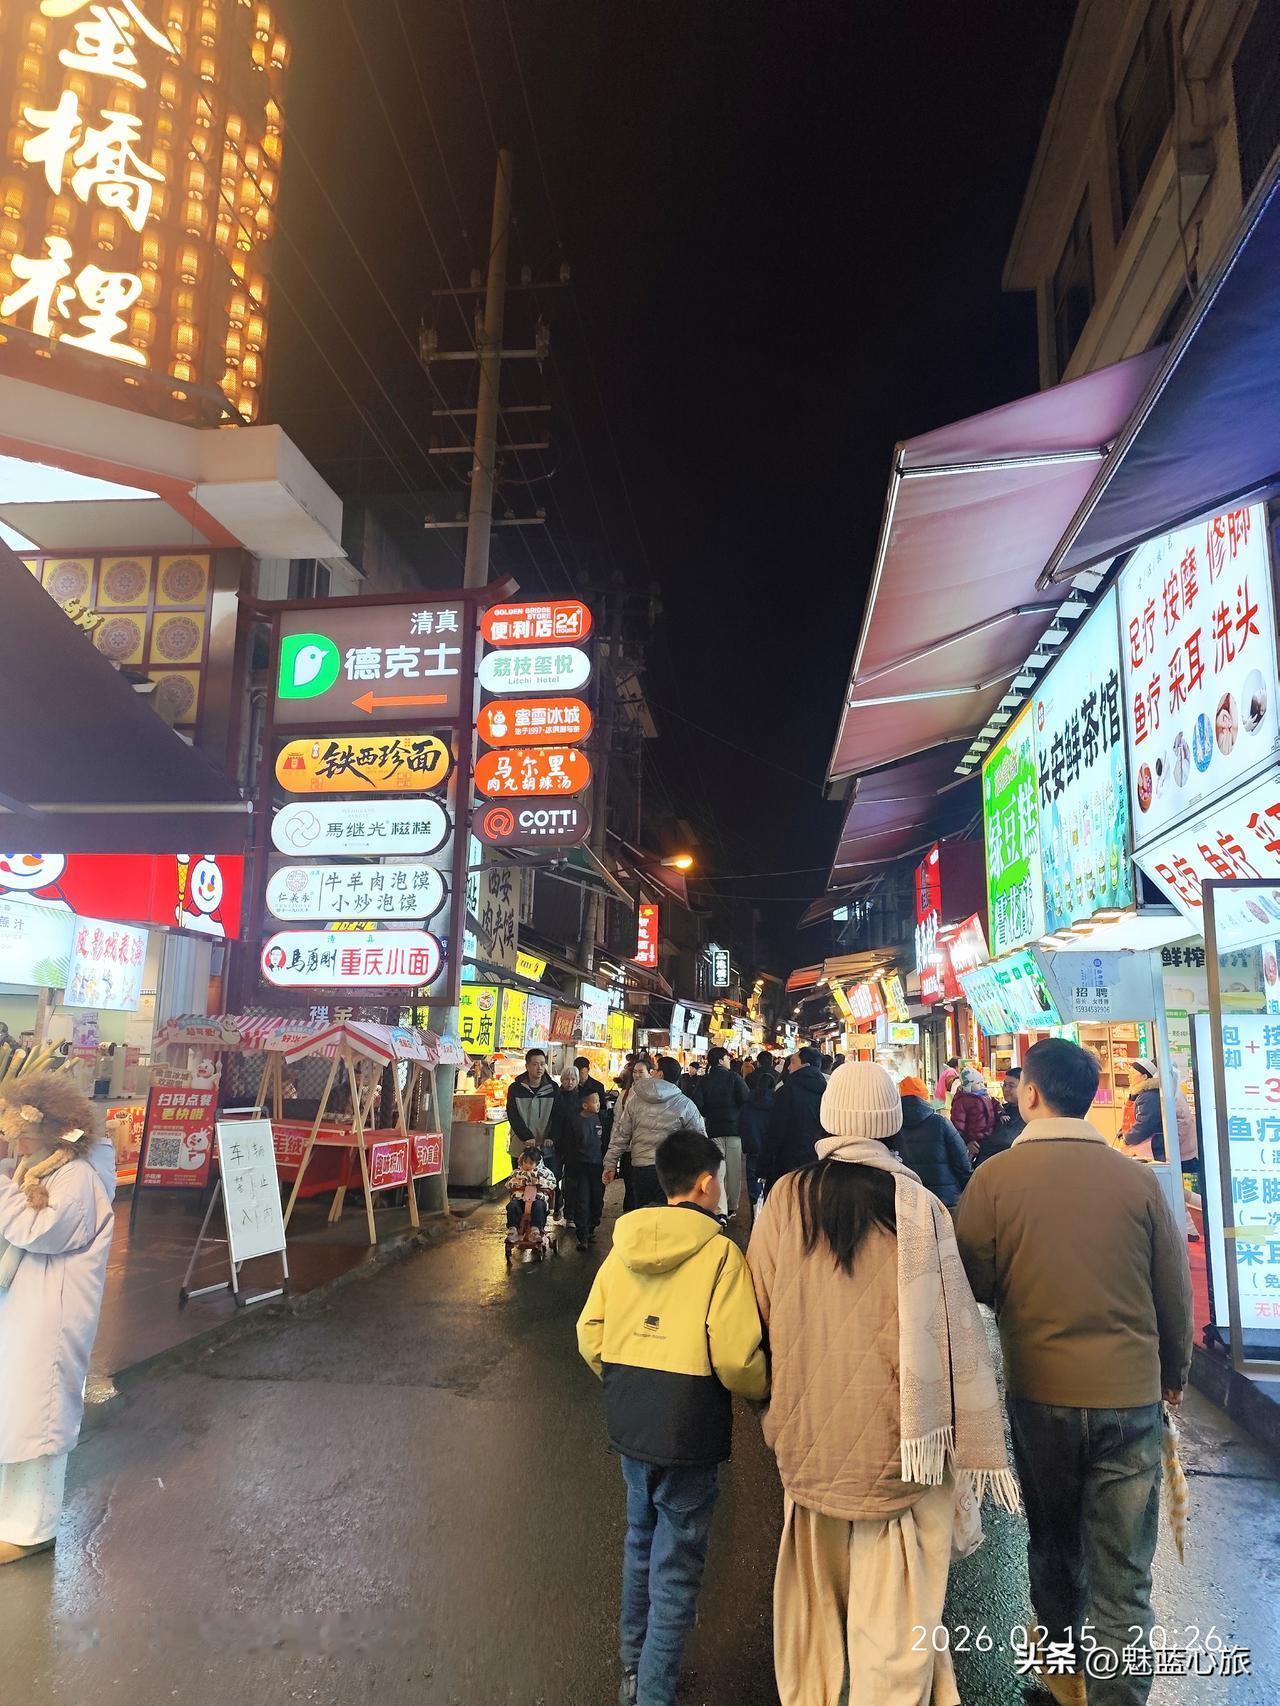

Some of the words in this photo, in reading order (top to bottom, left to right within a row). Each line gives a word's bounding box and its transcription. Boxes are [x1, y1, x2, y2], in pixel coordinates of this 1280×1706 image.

[1206, 508, 1251, 584] 修脚
[409, 609, 459, 635] 清真
[494, 608, 523, 616] GOLDEN
[525, 606, 551, 614] BRIDGE
[1129, 597, 1155, 675] 足疗
[1162, 546, 1198, 636] 按摩
[491, 619, 553, 640] 便利店
[344, 643, 461, 681] 德克士
[493, 654, 574, 677] 荔枝玺悦
[1134, 672, 1161, 746] 鱼疗
[1168, 627, 1205, 714] 采耳
[1212, 574, 1260, 674] 洗头
[508, 677, 532, 685] Litchi
[536, 676, 560, 684] Hotel
[515, 706, 580, 726] 蜜雪冰城
[1038, 668, 1121, 810] 长安鲜茶馆
[315, 739, 442, 788] 铁西珍面
[494, 755, 565, 779] 马尔里
[487, 775, 572, 791] 肉丸胡辣汤
[519, 809, 577, 827] COTTI
[989, 775, 1038, 880] 绿豆糕
[1154, 854, 1203, 909] 足疗
[1197, 829, 1263, 879] 鱼疗
[325, 870, 430, 893] 牛羊肉泡馍
[331, 893, 418, 914] 小炒泡馍
[341, 947, 430, 976] 重庆小面
[1161, 946, 1205, 968] 鲜榨
[1076, 987, 1108, 998] 招聘
[461, 1013, 493, 1046] 豆腐
[157, 1093, 213, 1106] 扫码点餐
